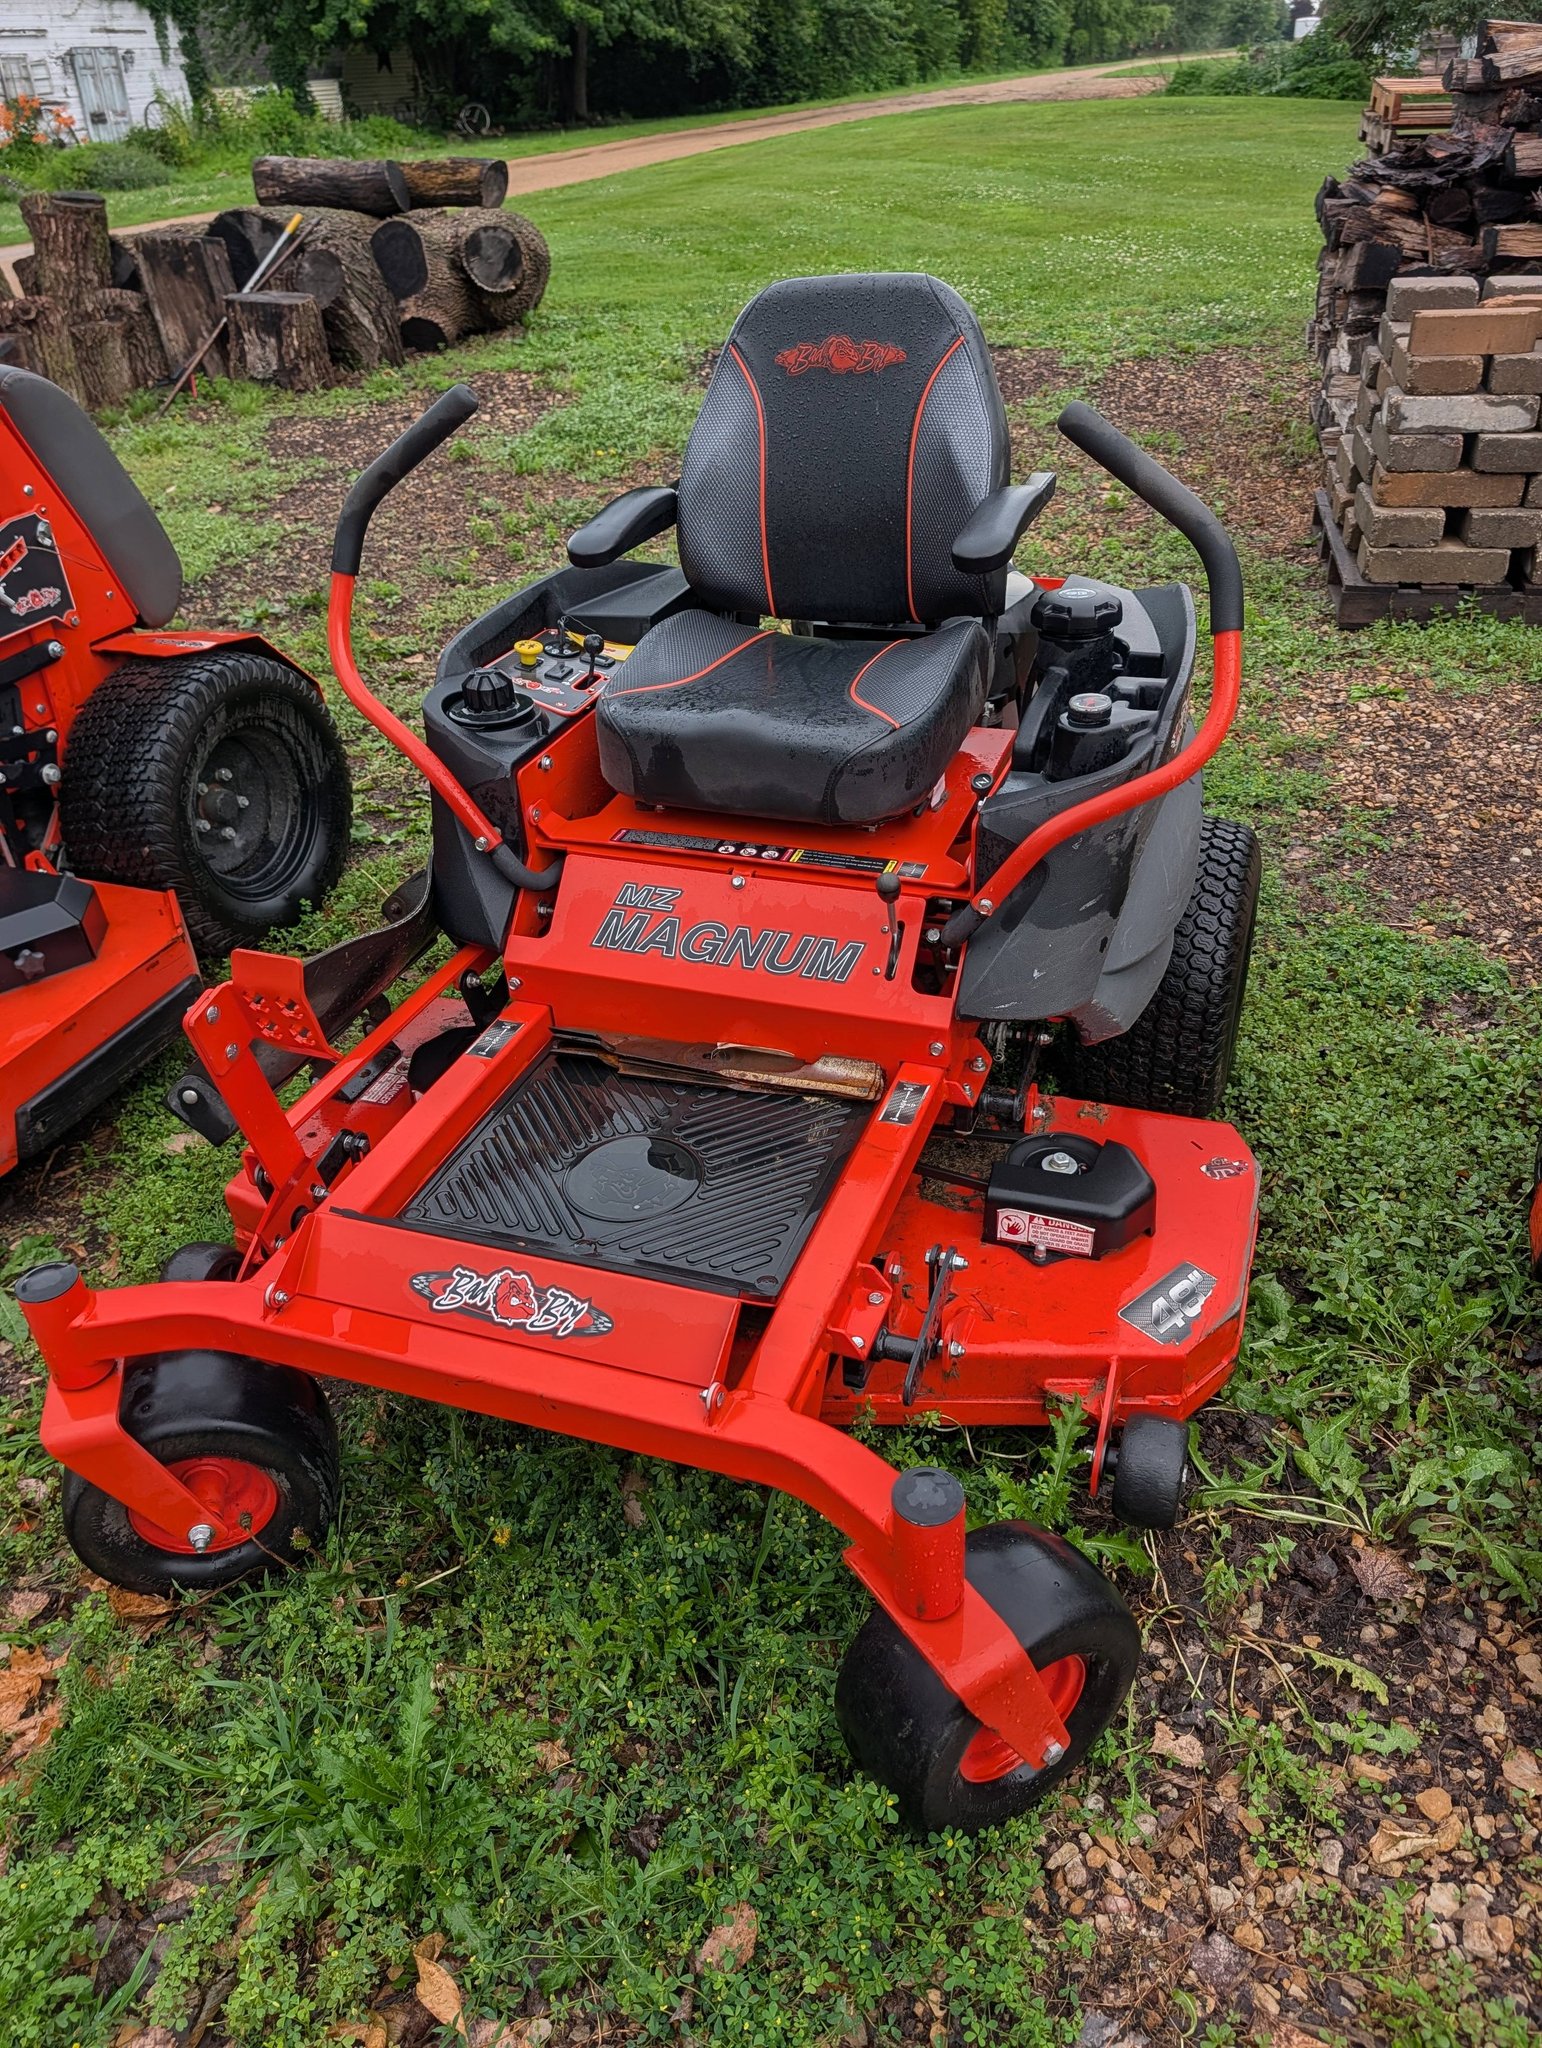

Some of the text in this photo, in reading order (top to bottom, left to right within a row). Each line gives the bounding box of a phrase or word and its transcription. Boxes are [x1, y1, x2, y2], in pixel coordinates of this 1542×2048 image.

[787, 340, 891, 375] Bad Boy
[614, 882, 683, 911] MZ
[590, 907, 866, 983] MAGNUM
[1048, 1219, 1088, 1232] DANG
[433, 1267, 590, 1336] Bad Boy
